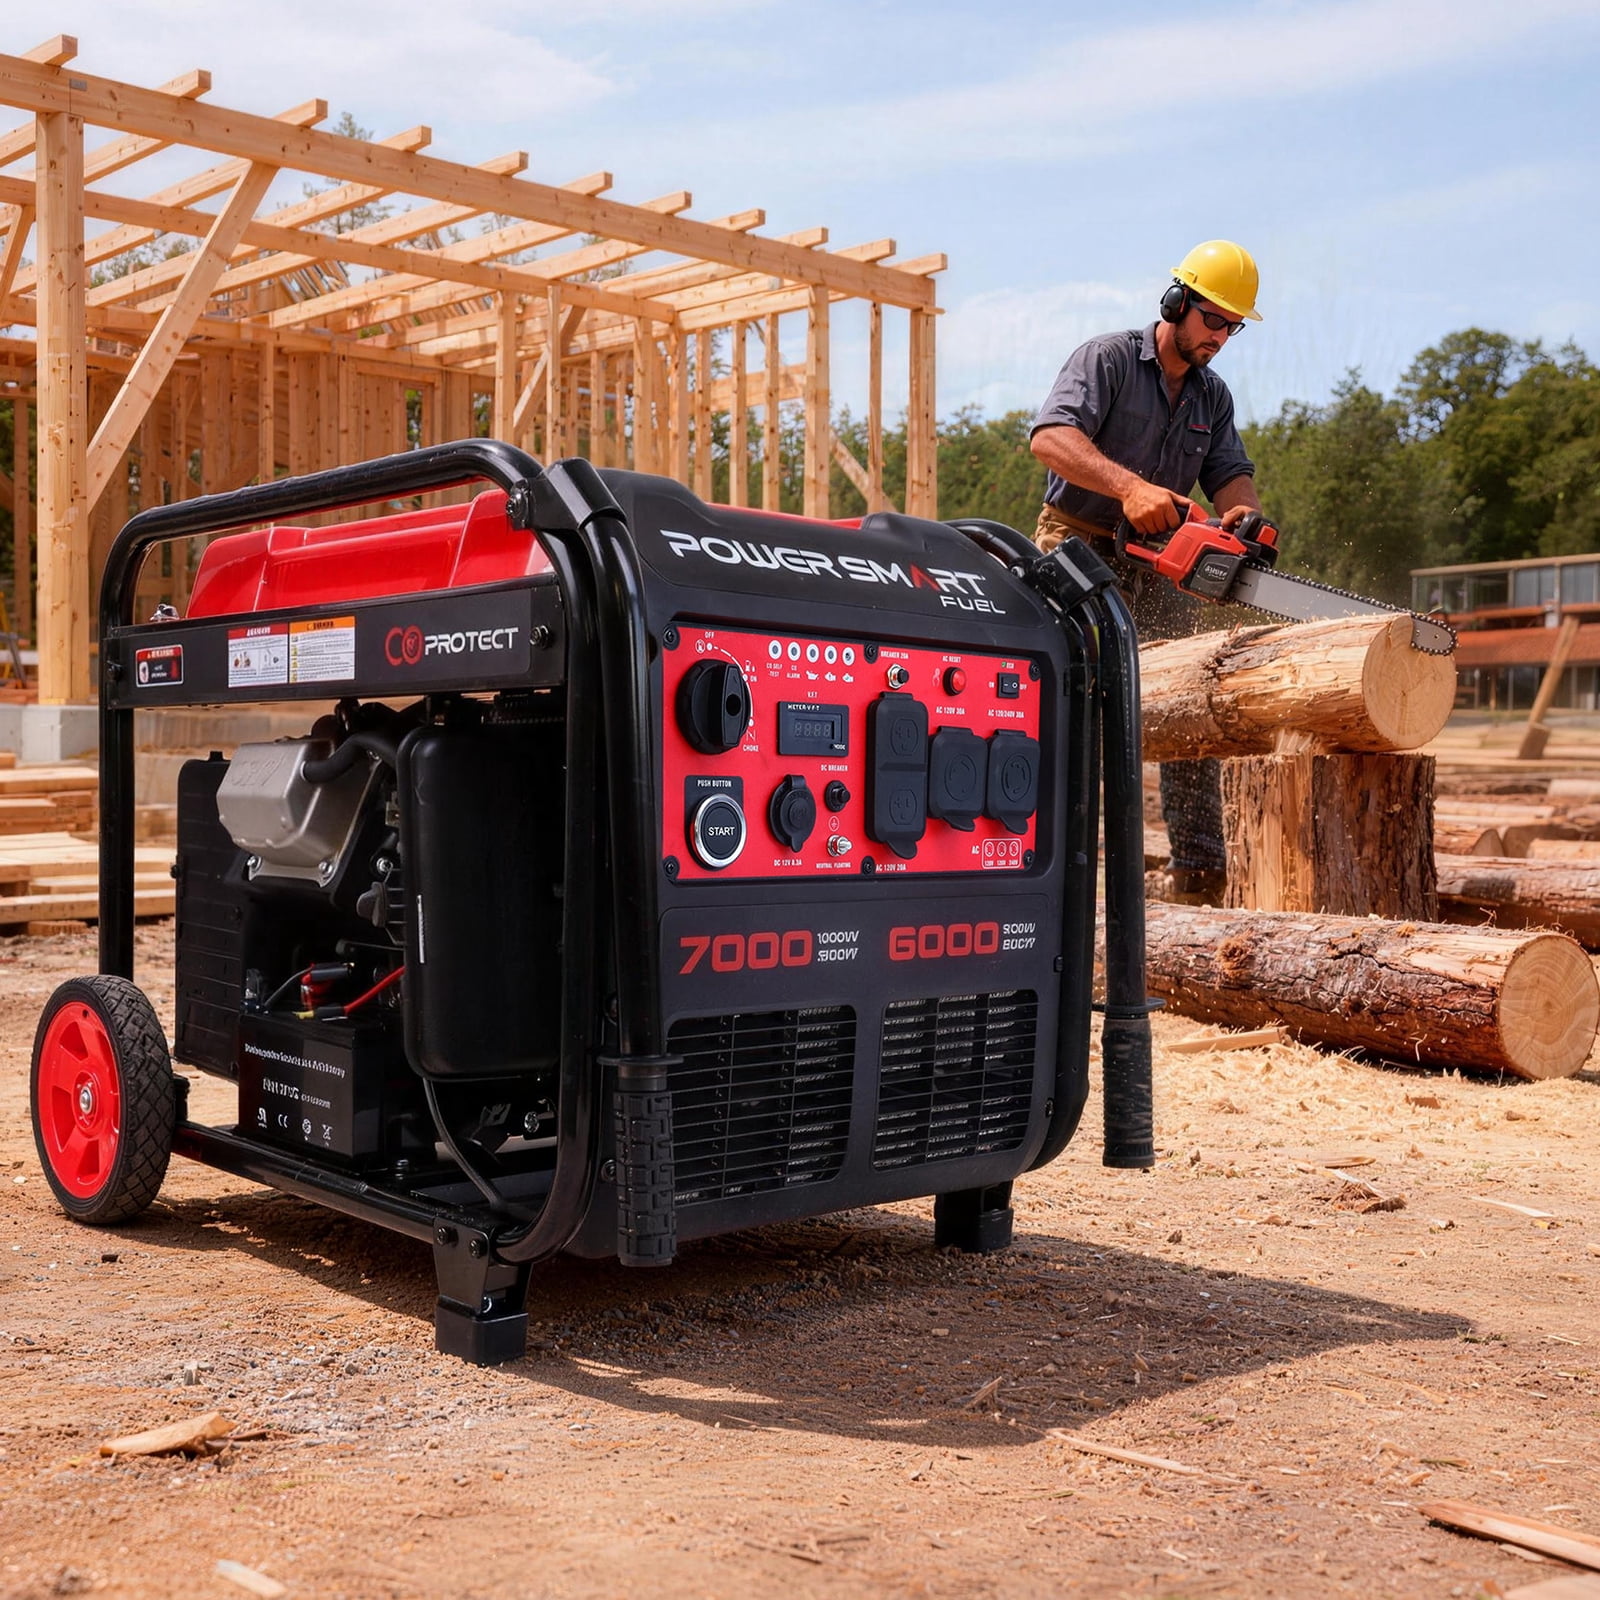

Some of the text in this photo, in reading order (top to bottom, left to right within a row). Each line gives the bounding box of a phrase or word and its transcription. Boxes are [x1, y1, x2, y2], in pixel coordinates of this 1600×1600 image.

[940, 595, 1006, 614] FUEL
[424, 627, 519, 656] PROTECT
[935, 706, 966, 715] AC 120V 30A
[987, 709, 995, 717] AC
[697, 779, 732, 788] PUSH BUTTON
[708, 826, 735, 837] START
[971, 845, 980, 854] AC
[875, 863, 907, 872] AC 120V 20A
[817, 930, 860, 944] 1000W
[889, 922, 999, 961] 6000
[679, 930, 813, 975] 7000
